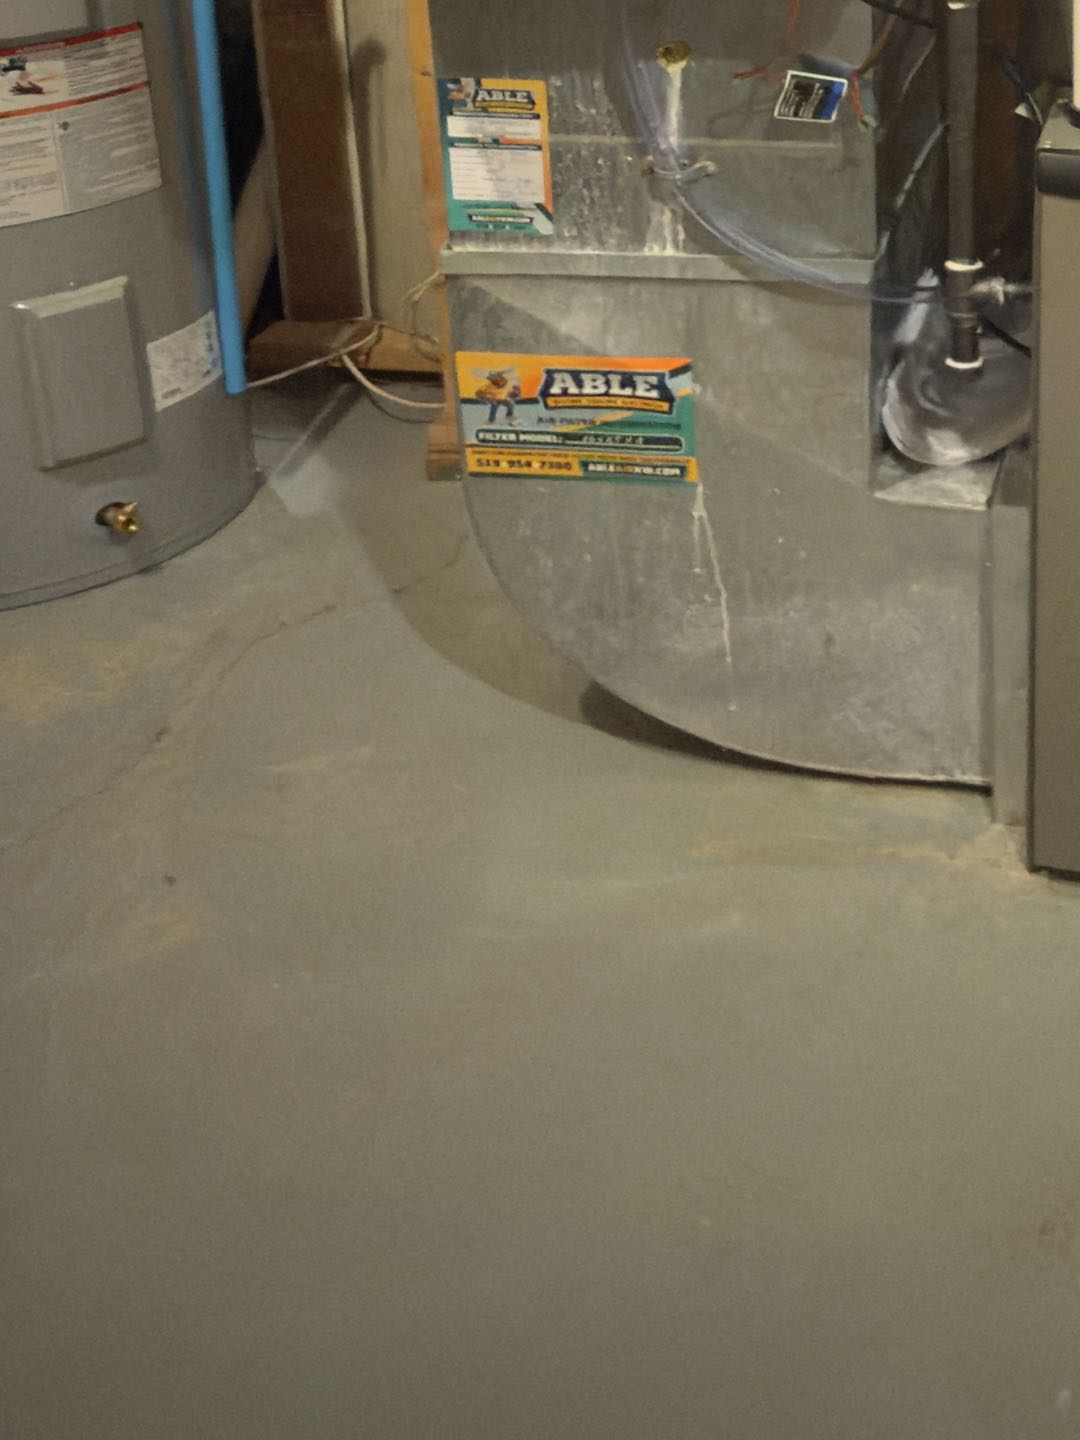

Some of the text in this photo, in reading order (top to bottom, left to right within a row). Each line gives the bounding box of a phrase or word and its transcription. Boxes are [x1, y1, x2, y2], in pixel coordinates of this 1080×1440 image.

[476, 90, 529, 102] ABLE
[549, 371, 661, 399] ABLE
[478, 431, 516, 442] FILTER
